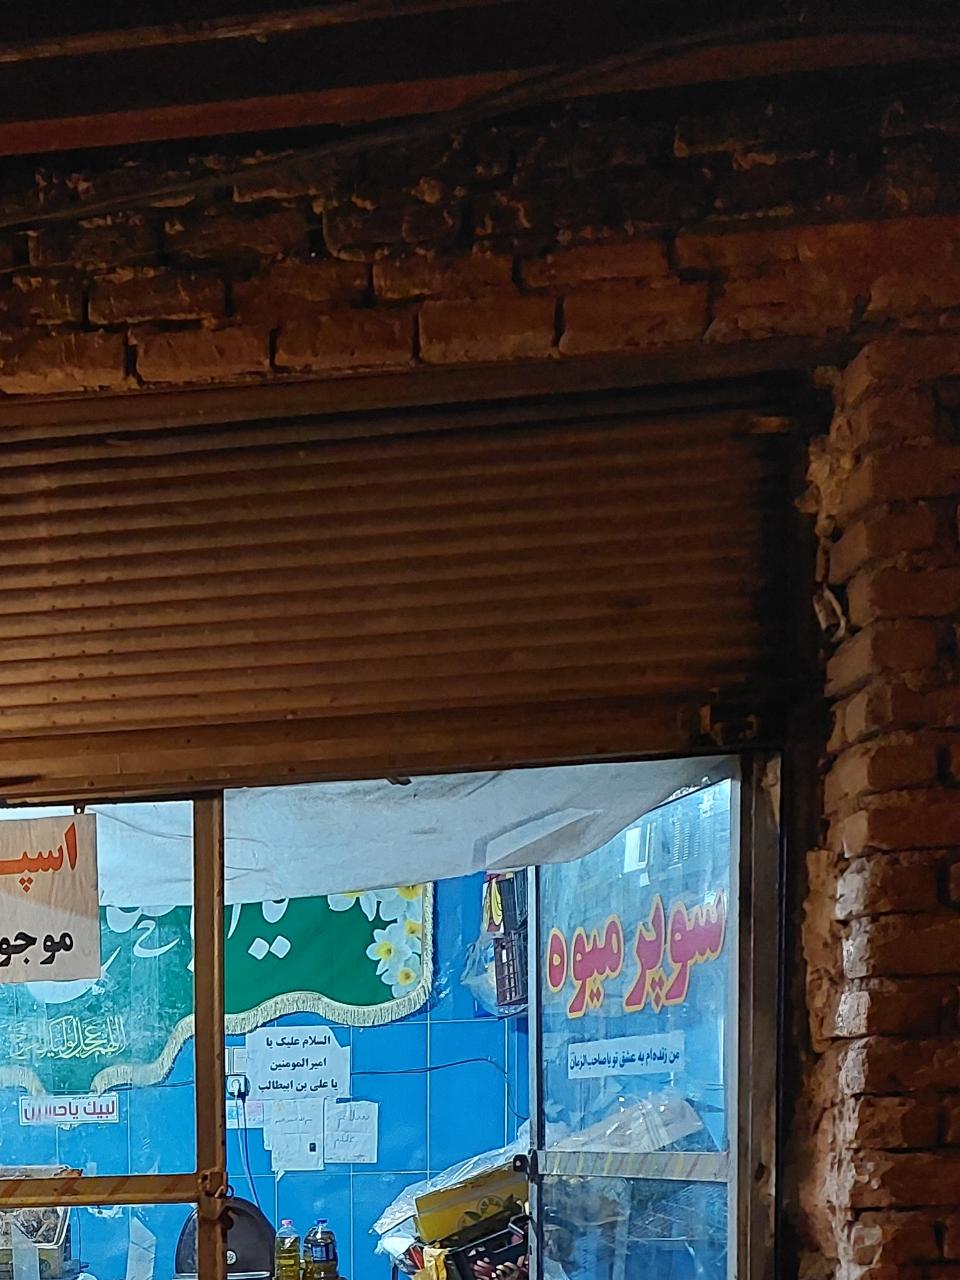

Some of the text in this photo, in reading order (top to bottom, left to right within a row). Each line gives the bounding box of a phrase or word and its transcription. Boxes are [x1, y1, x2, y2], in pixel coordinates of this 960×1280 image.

[547, 888, 727, 1019] سوپر میوه
[265, 1035, 331, 1048] السلام علیک یا
[619, 1050, 636, 1068] عشق
[637, 1051, 645, 1066] به
[669, 1048, 680, 1064] من
[295, 1082, 307, 1092] بن
[309, 1079, 328, 1092] علی
[330, 1079, 338, 1091] یا
